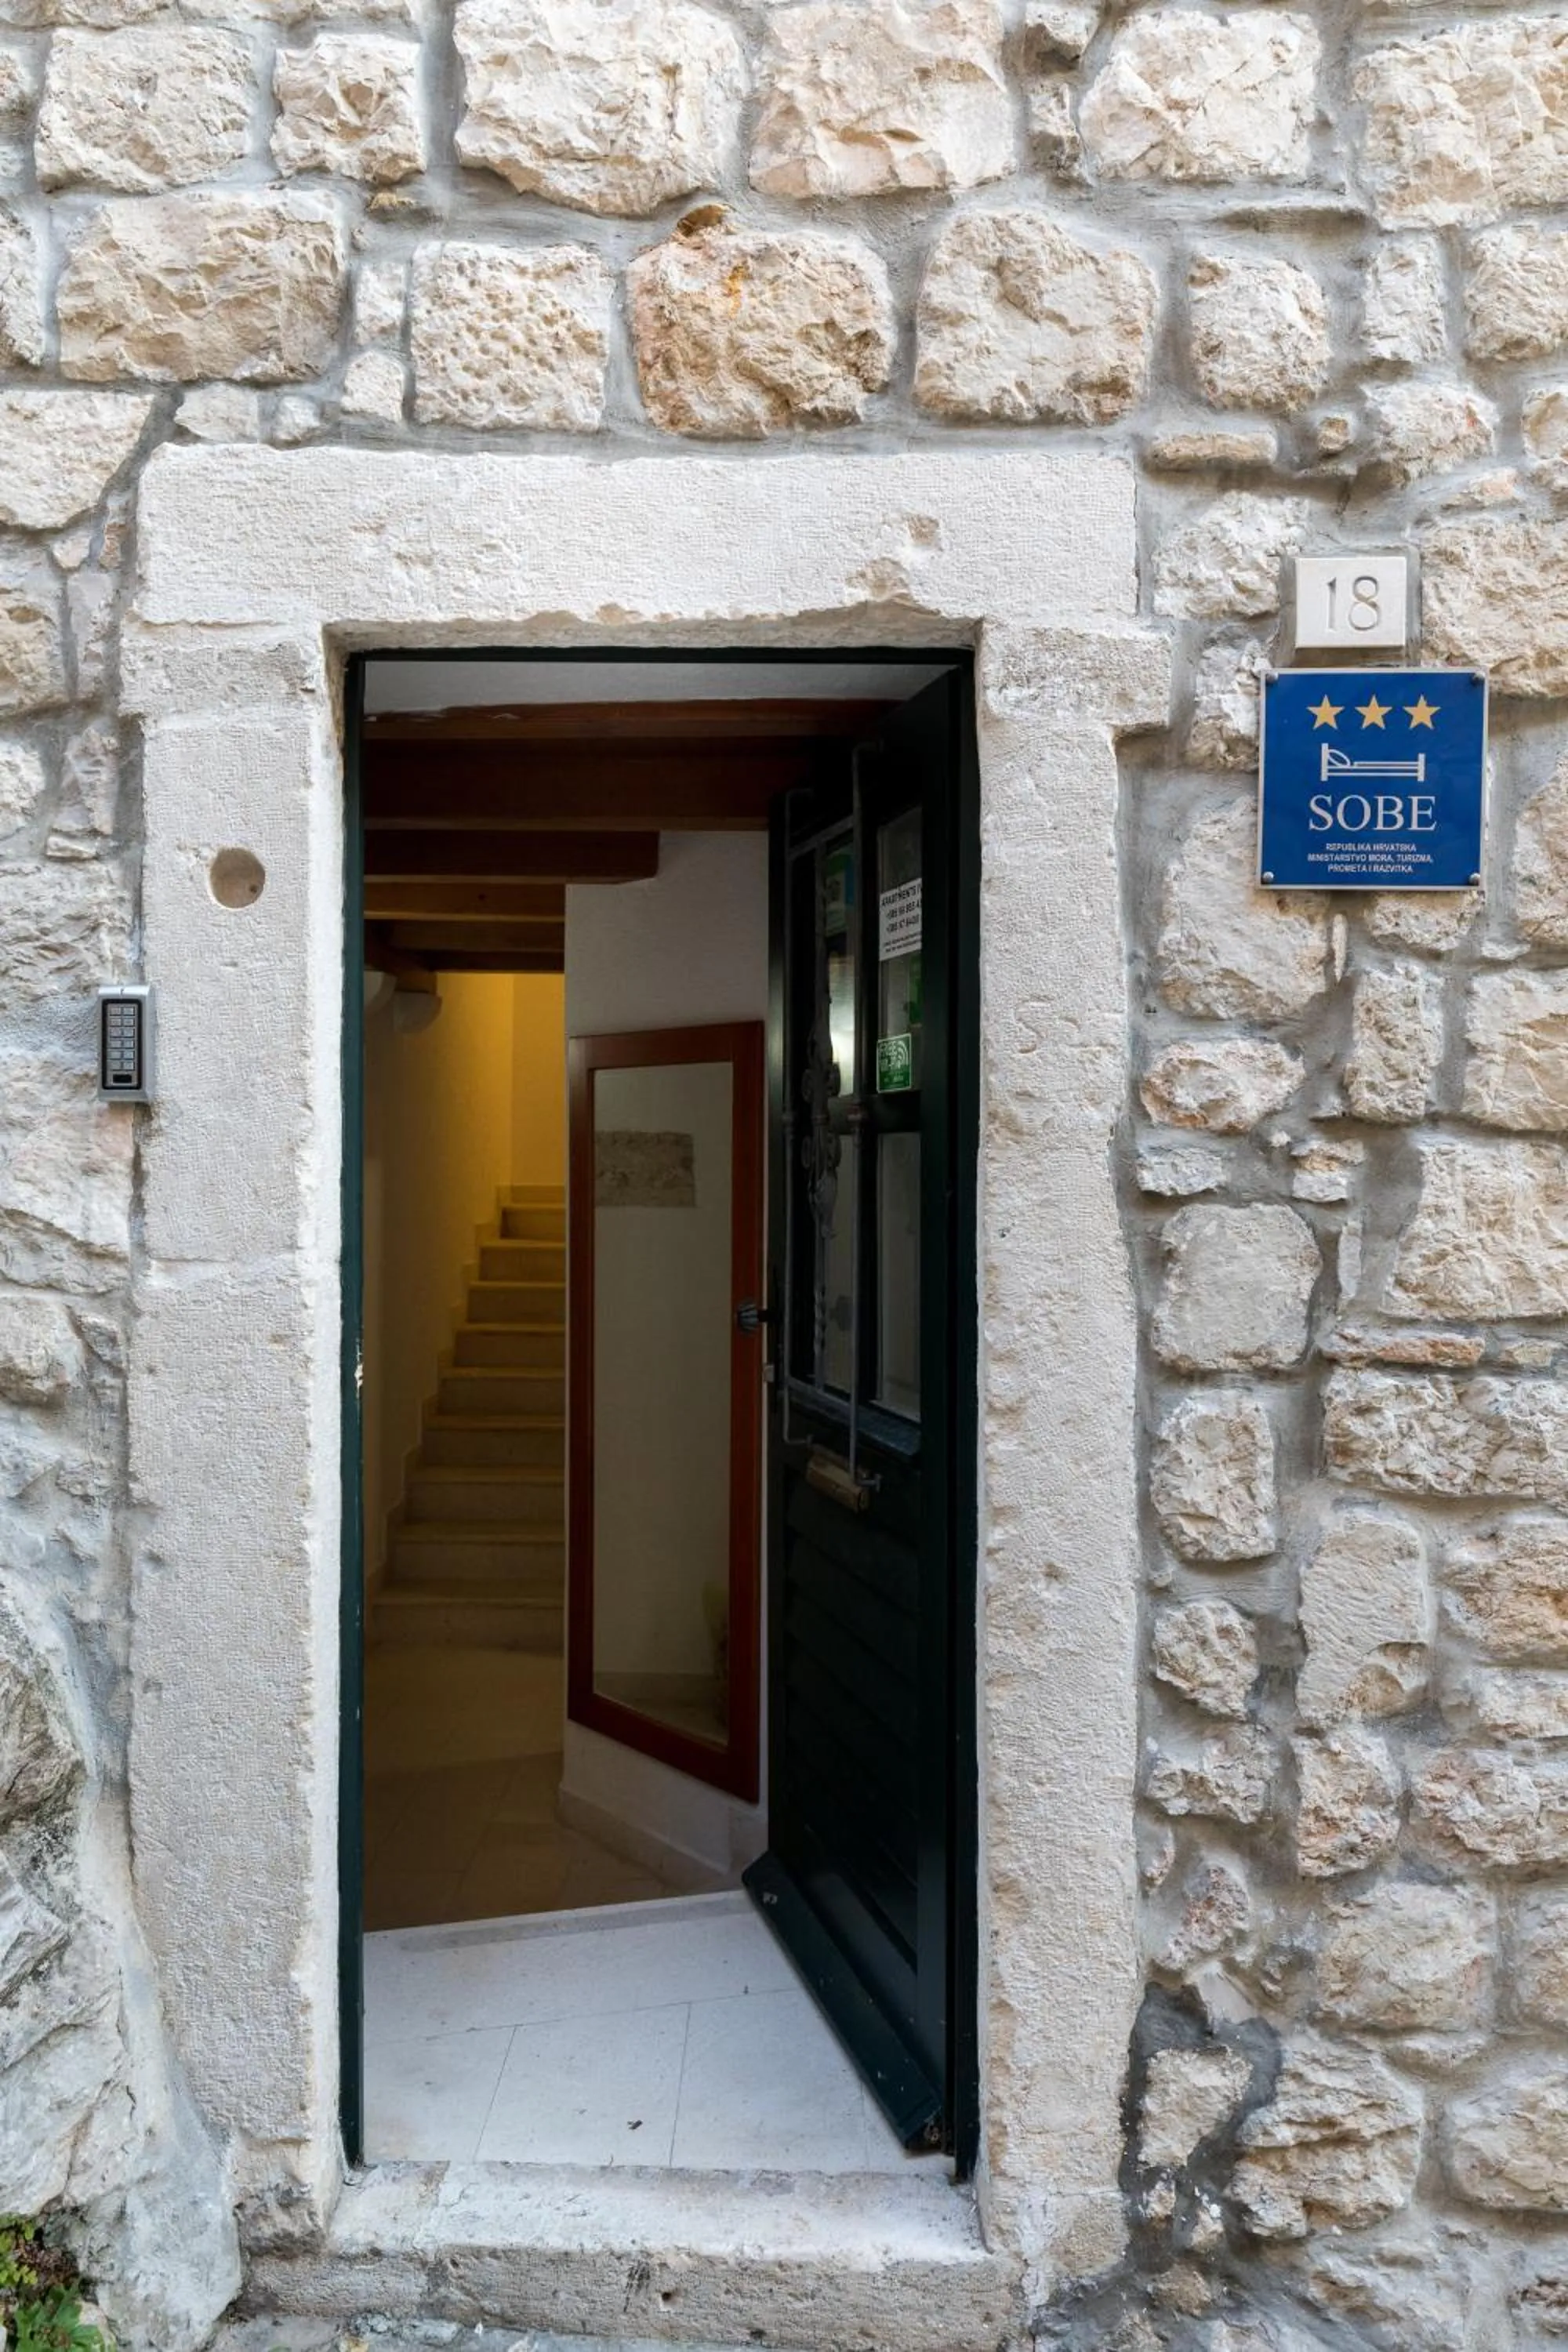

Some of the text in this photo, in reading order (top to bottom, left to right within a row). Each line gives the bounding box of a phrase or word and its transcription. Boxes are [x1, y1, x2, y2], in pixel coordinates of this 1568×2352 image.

[1326, 575, 1381, 633] 18
[1308, 793, 1437, 831] SOBE
[1326, 843, 1417, 852] REPUBLIKA HRVATSKA
[1308, 853, 1367, 862] MINISTARSTVO
[1328, 864, 1367, 873] PROMETA
